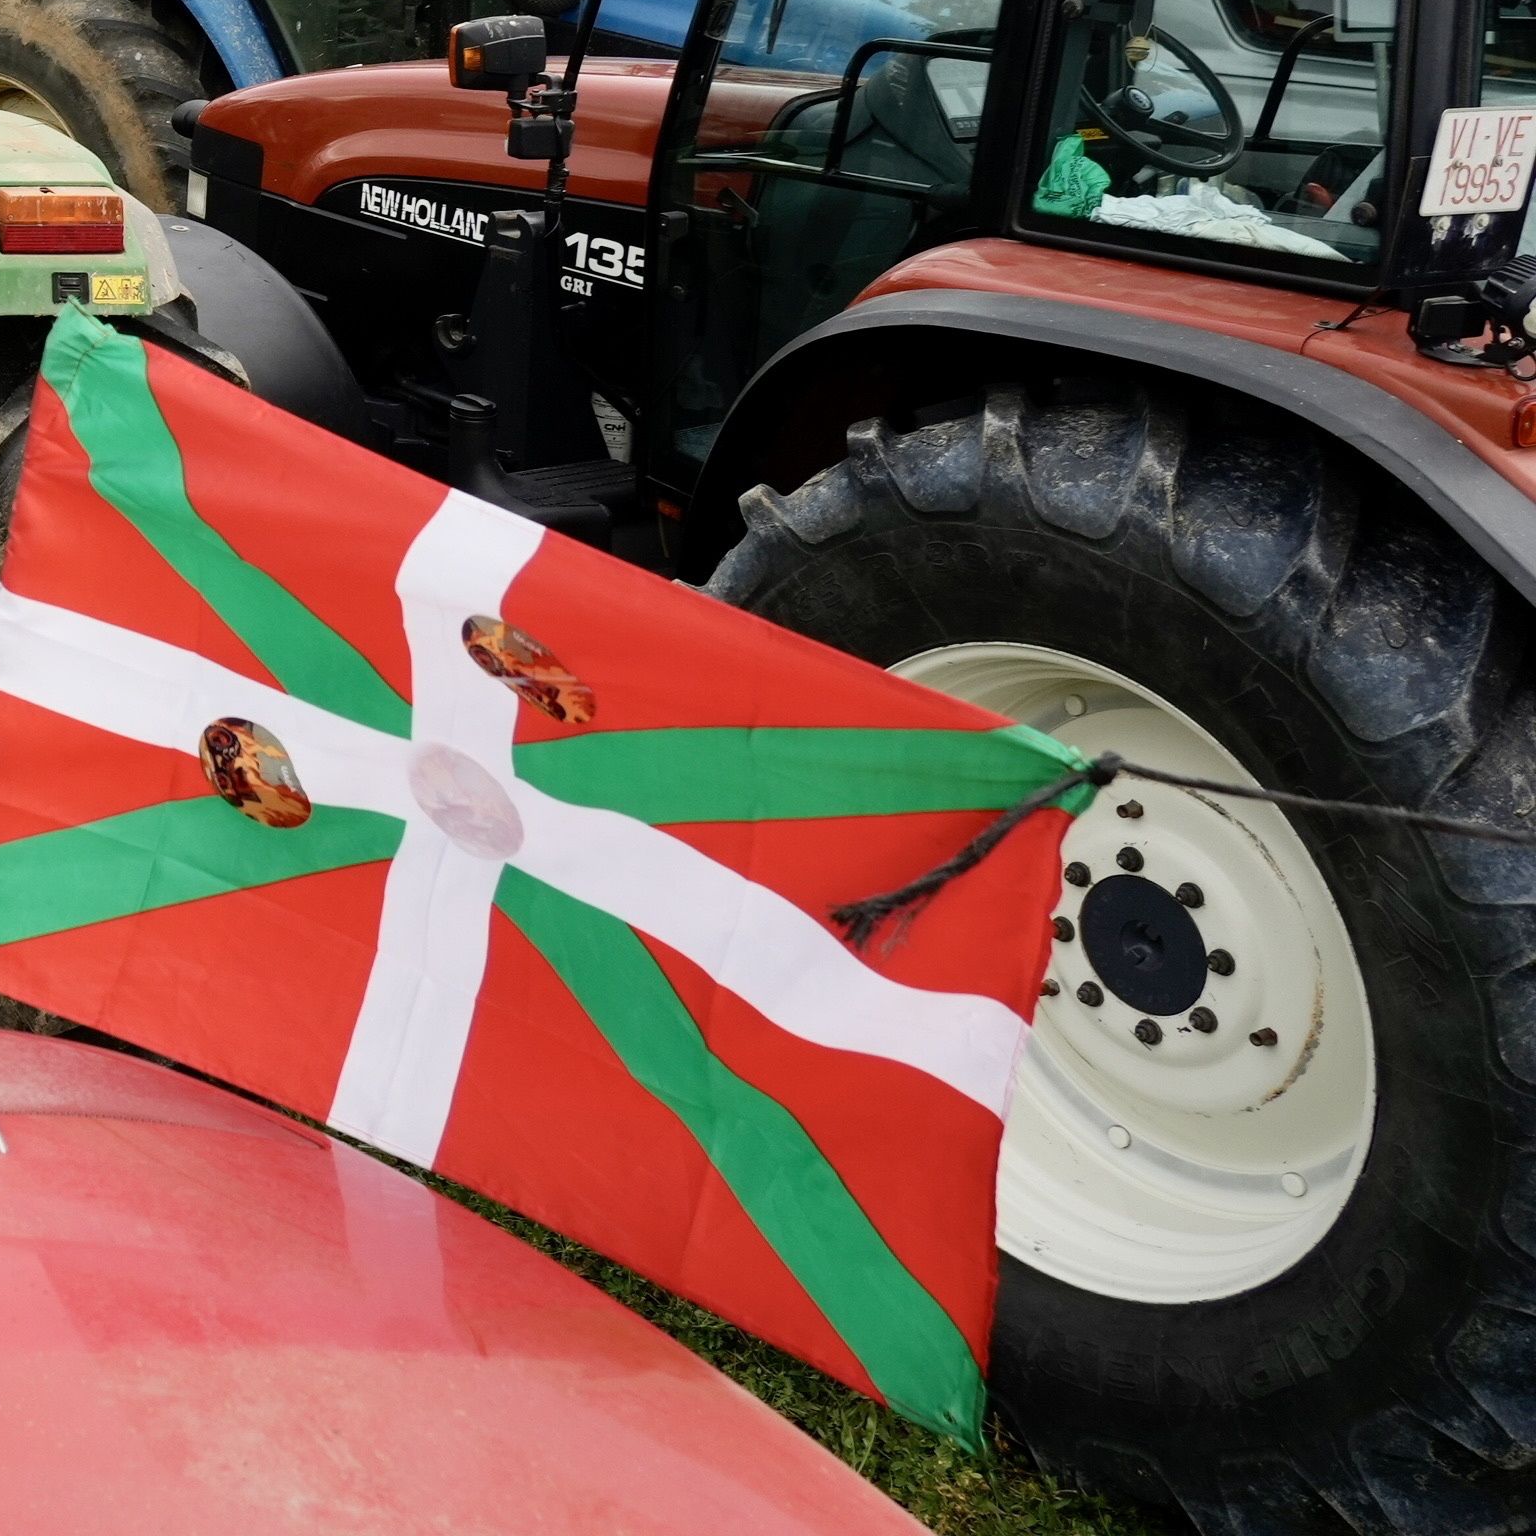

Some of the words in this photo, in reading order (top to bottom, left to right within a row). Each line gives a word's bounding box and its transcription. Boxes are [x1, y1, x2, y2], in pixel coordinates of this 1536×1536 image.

[360, 182, 402, 219] NEW
[1439, 162, 1520, 206] 19953
[564, 232, 646, 284] 135
[560, 275, 593, 297] GRI
